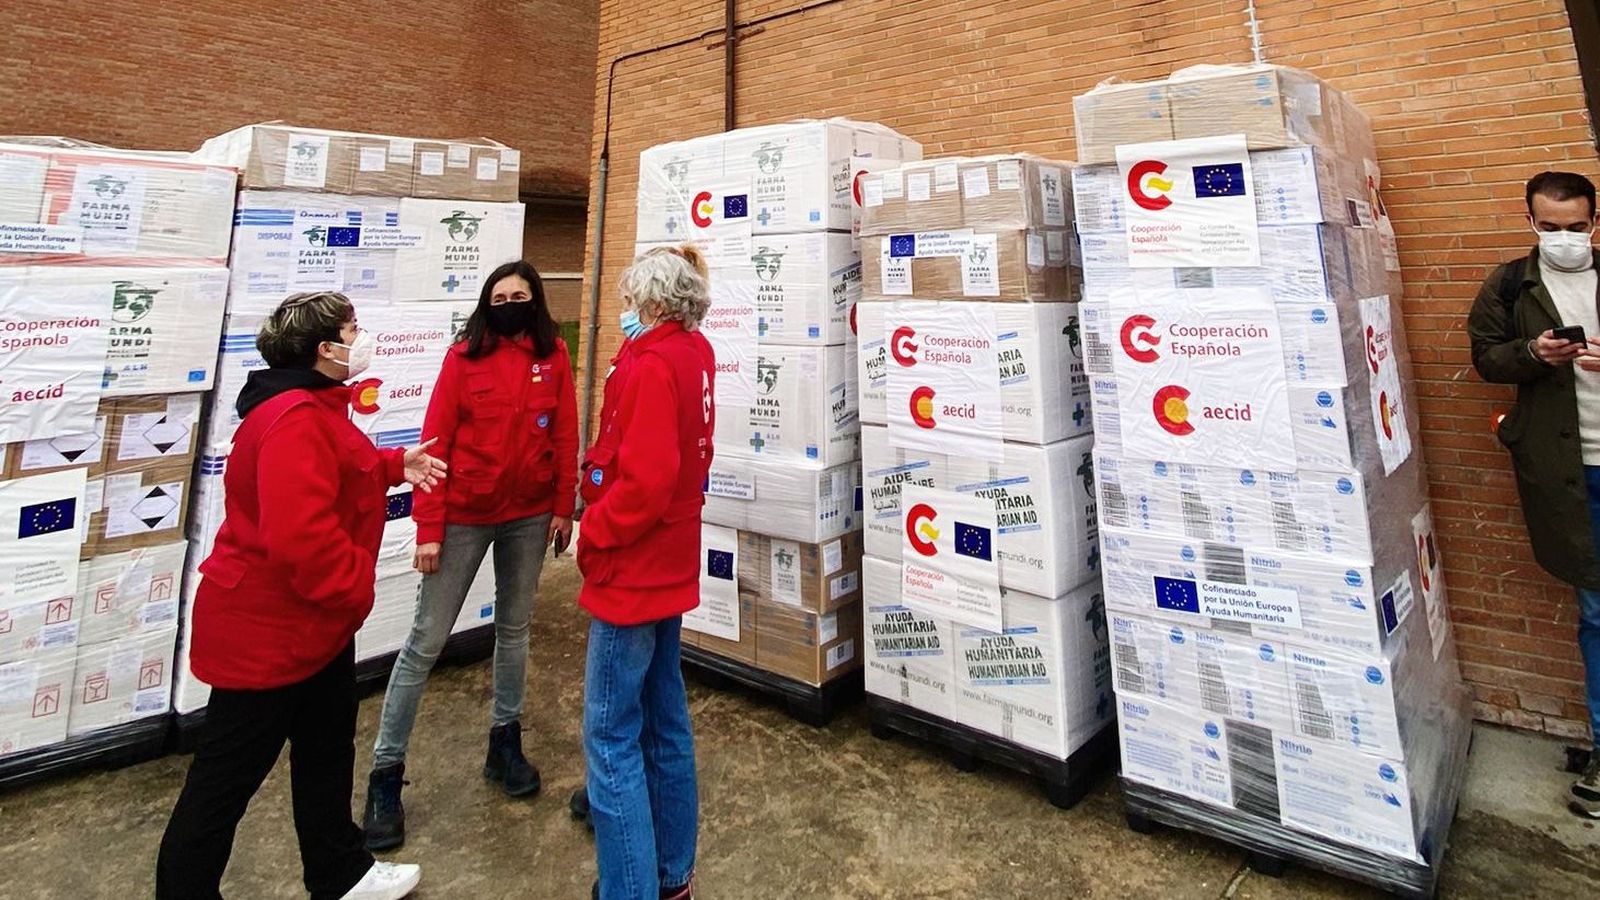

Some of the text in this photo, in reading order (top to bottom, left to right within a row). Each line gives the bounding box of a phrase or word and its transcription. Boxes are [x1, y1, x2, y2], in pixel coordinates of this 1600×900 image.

[757, 176, 786, 185] FARMA
[757, 185, 786, 194] MUNDI
[82, 202, 131, 211] FARMA
[80, 212, 130, 221] MUNDI
[1130, 223, 1182, 234] Cooperación
[1131, 234, 1169, 244] Española
[444, 245, 480, 253] FARMA
[298, 258, 336, 266] MUNDI
[705, 319, 740, 329] Española
[1168, 322, 1269, 340] Cooperación
[0, 333, 69, 351] spañola
[376, 330, 445, 346] Cooperación
[924, 334, 990, 350] Cooperación
[375, 343, 425, 357] Española
[924, 350, 972, 365] Española
[1170, 342, 1242, 358] Española
[1012, 361, 1026, 377] AID
[12, 384, 64, 402] aecid
[389, 384, 423, 400] aecid
[750, 408, 780, 418] MUNDI
[943, 404, 976, 420] aecid
[1203, 403, 1253, 422] aecid
[884, 472, 913, 486] AIDE
[975, 487, 1009, 499] AYUDA
[996, 510, 1038, 527] ARIAN AID
[905, 565, 945, 583] Cooperación
[905, 575, 934, 590] Española
[1202, 583, 1258, 597] Cofinanciado
[1204, 596, 1293, 613] por la Unión Europea
[884, 611, 915, 622] AYUDA
[1205, 606, 1286, 623] Ayuda Humanitaria
[871, 620, 938, 635] HUMANITARIA
[873, 634, 940, 651] HUMANITARIAN AID
[980, 636, 1016, 649] AYUDA
[965, 646, 1043, 662] HUMANITARIA
[967, 662, 1047, 680] HUMANITARIAN AID
